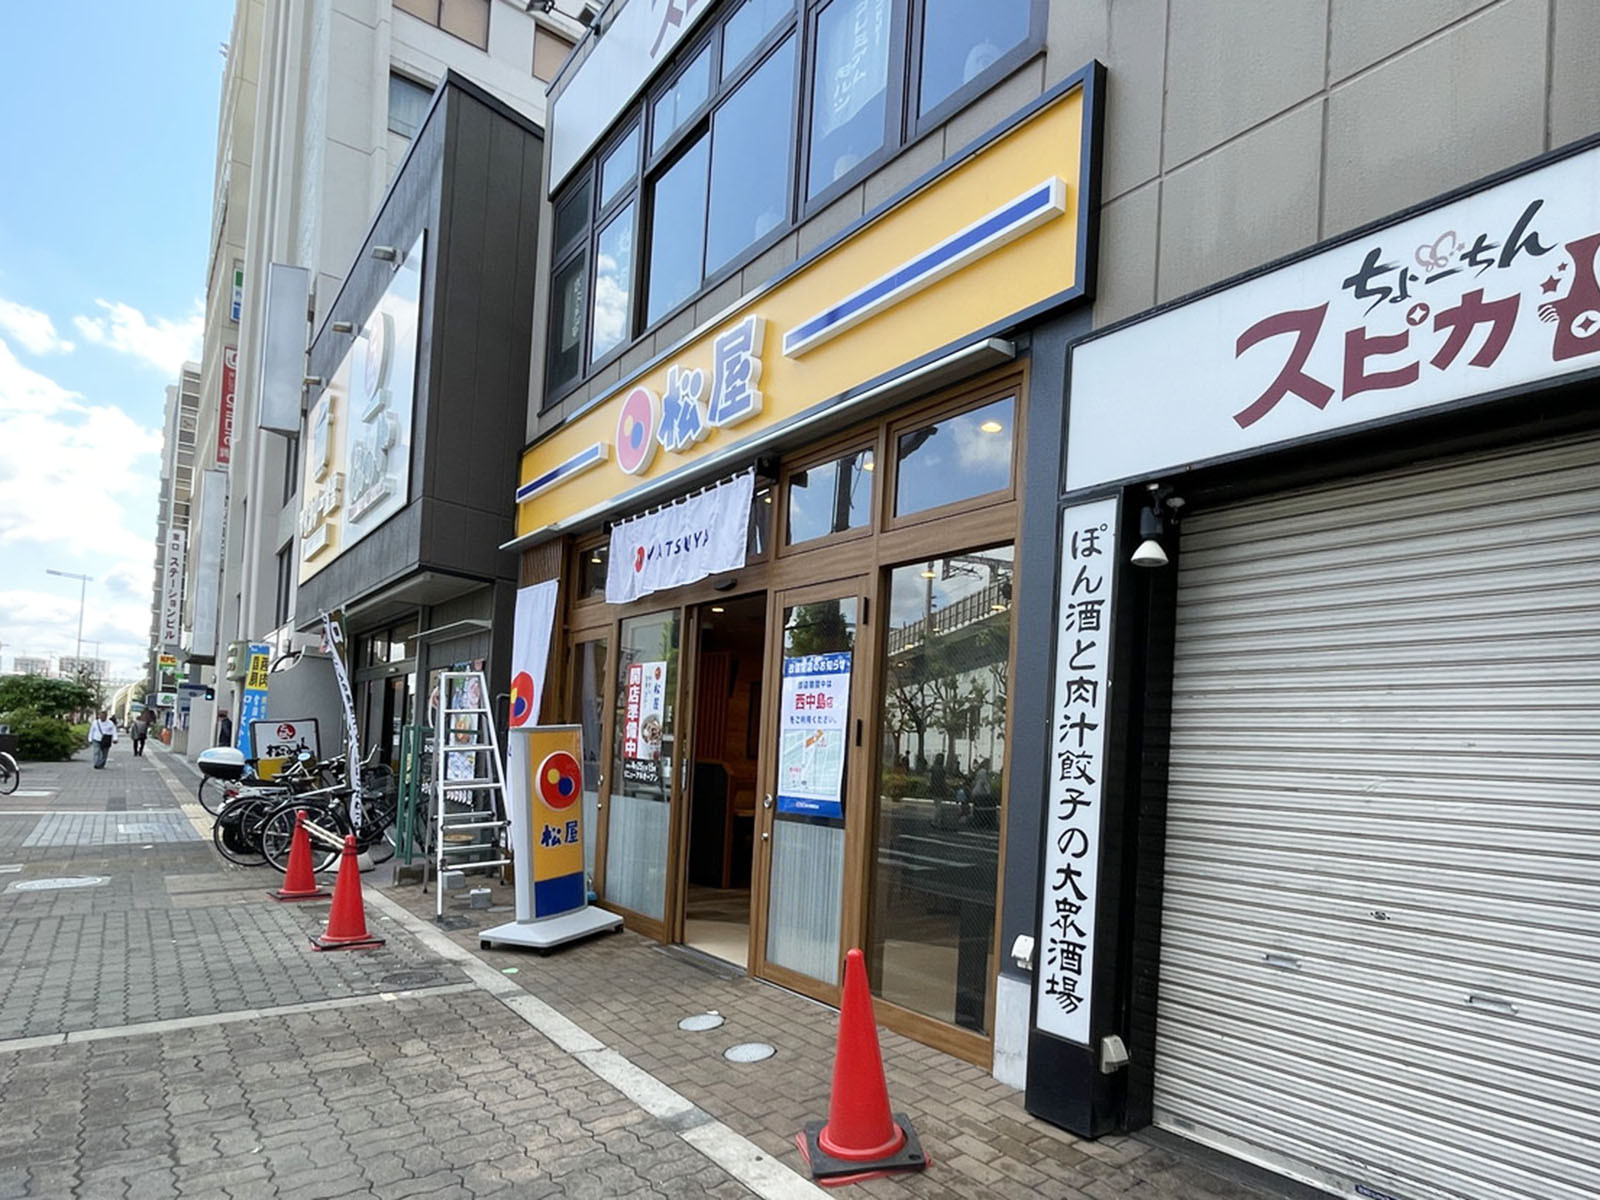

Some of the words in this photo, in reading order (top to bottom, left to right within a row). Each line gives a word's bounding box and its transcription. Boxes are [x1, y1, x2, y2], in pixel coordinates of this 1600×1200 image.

[1342, 199, 1558, 317] ちょーちん
[656, 314, 763, 453] 松屋
[1233, 288, 1521, 429] スピカ
[164, 556, 180, 641] ステーションビル
[1045, 523, 1108, 1014] ぽん酒と肉汁餃子の大衆酒場
[540, 820, 579, 848] 松屋
